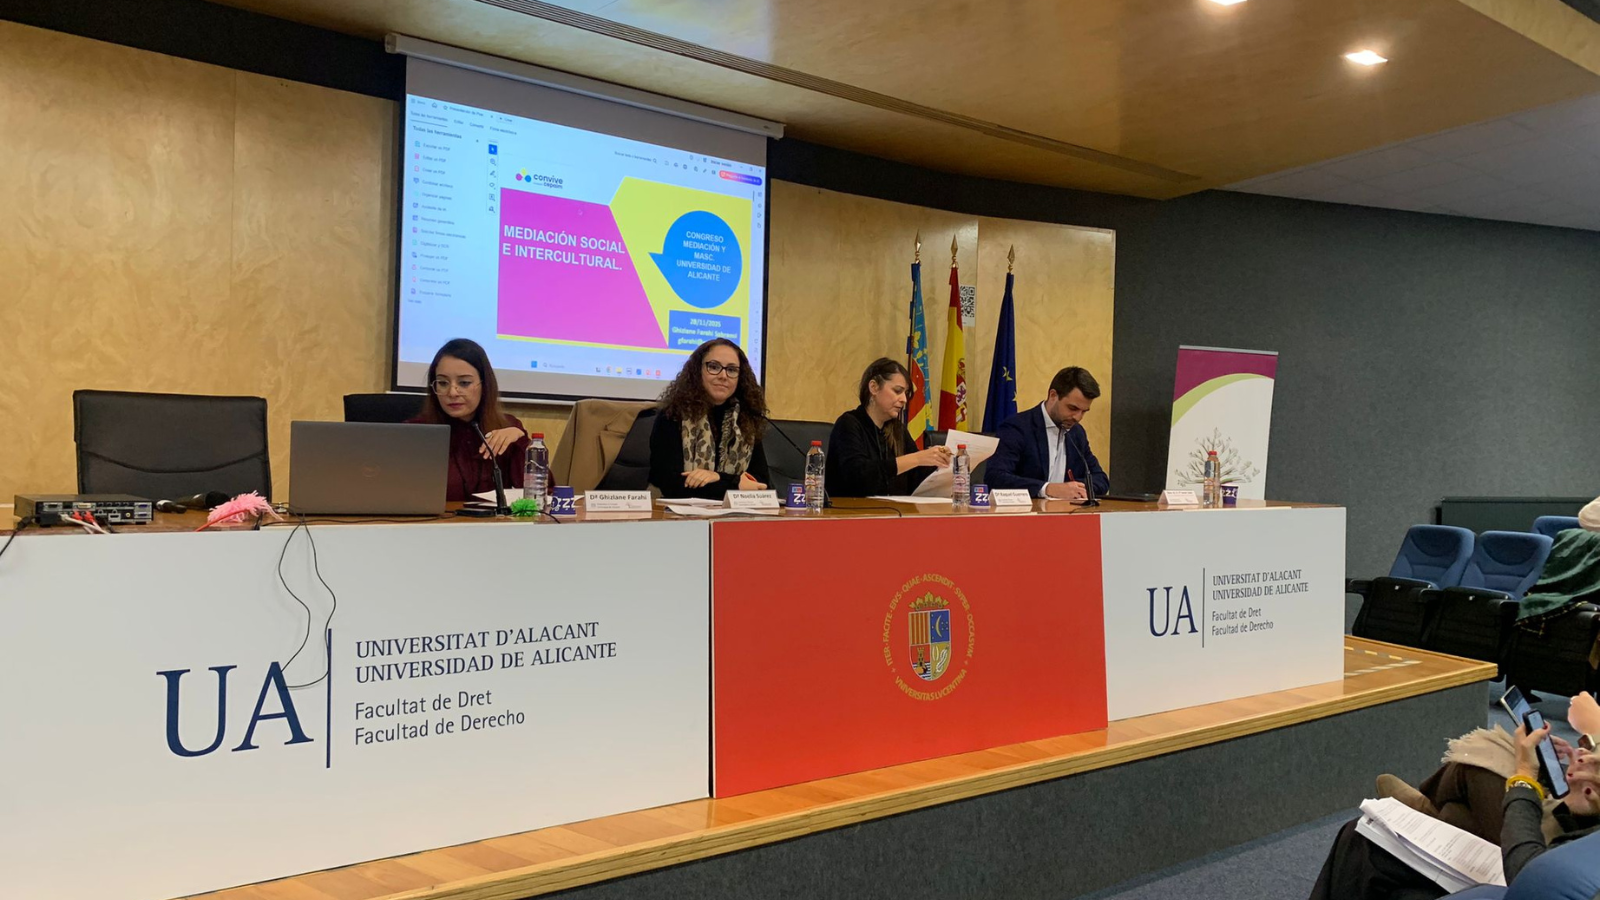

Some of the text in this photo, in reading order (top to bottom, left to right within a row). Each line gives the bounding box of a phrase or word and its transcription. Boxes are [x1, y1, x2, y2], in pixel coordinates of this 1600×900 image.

[533, 174, 563, 184] convive
[504, 225, 625, 254] MEDIACIÓN SOCIAL
[683, 240, 720, 252] MEDIACIÓN
[686, 231, 724, 243] CONGRESO
[502, 243, 622, 270] E INTERCULTURAL.
[676, 259, 721, 272] UNIVERSIDAD
[687, 271, 720, 281] ALICANTE
[1212, 570, 1302, 586] UNIVERSITAT D'ALACANT
[1212, 582, 1309, 600] UNIVERSIDAD DE ALICANTE
[1146, 585, 1198, 637] UA
[1212, 607, 1261, 621] Facultat de Dret
[1212, 620, 1274, 636] Facultad de Derecho
[356, 621, 599, 658] UNIVERSITAT D'ALACANT
[355, 642, 617, 683] UNIVERSIDAD DE ALICANTE
[156, 661, 314, 758] UA
[356, 690, 492, 720] Facultat de Dret
[355, 709, 525, 745] Facultad de Derecho
